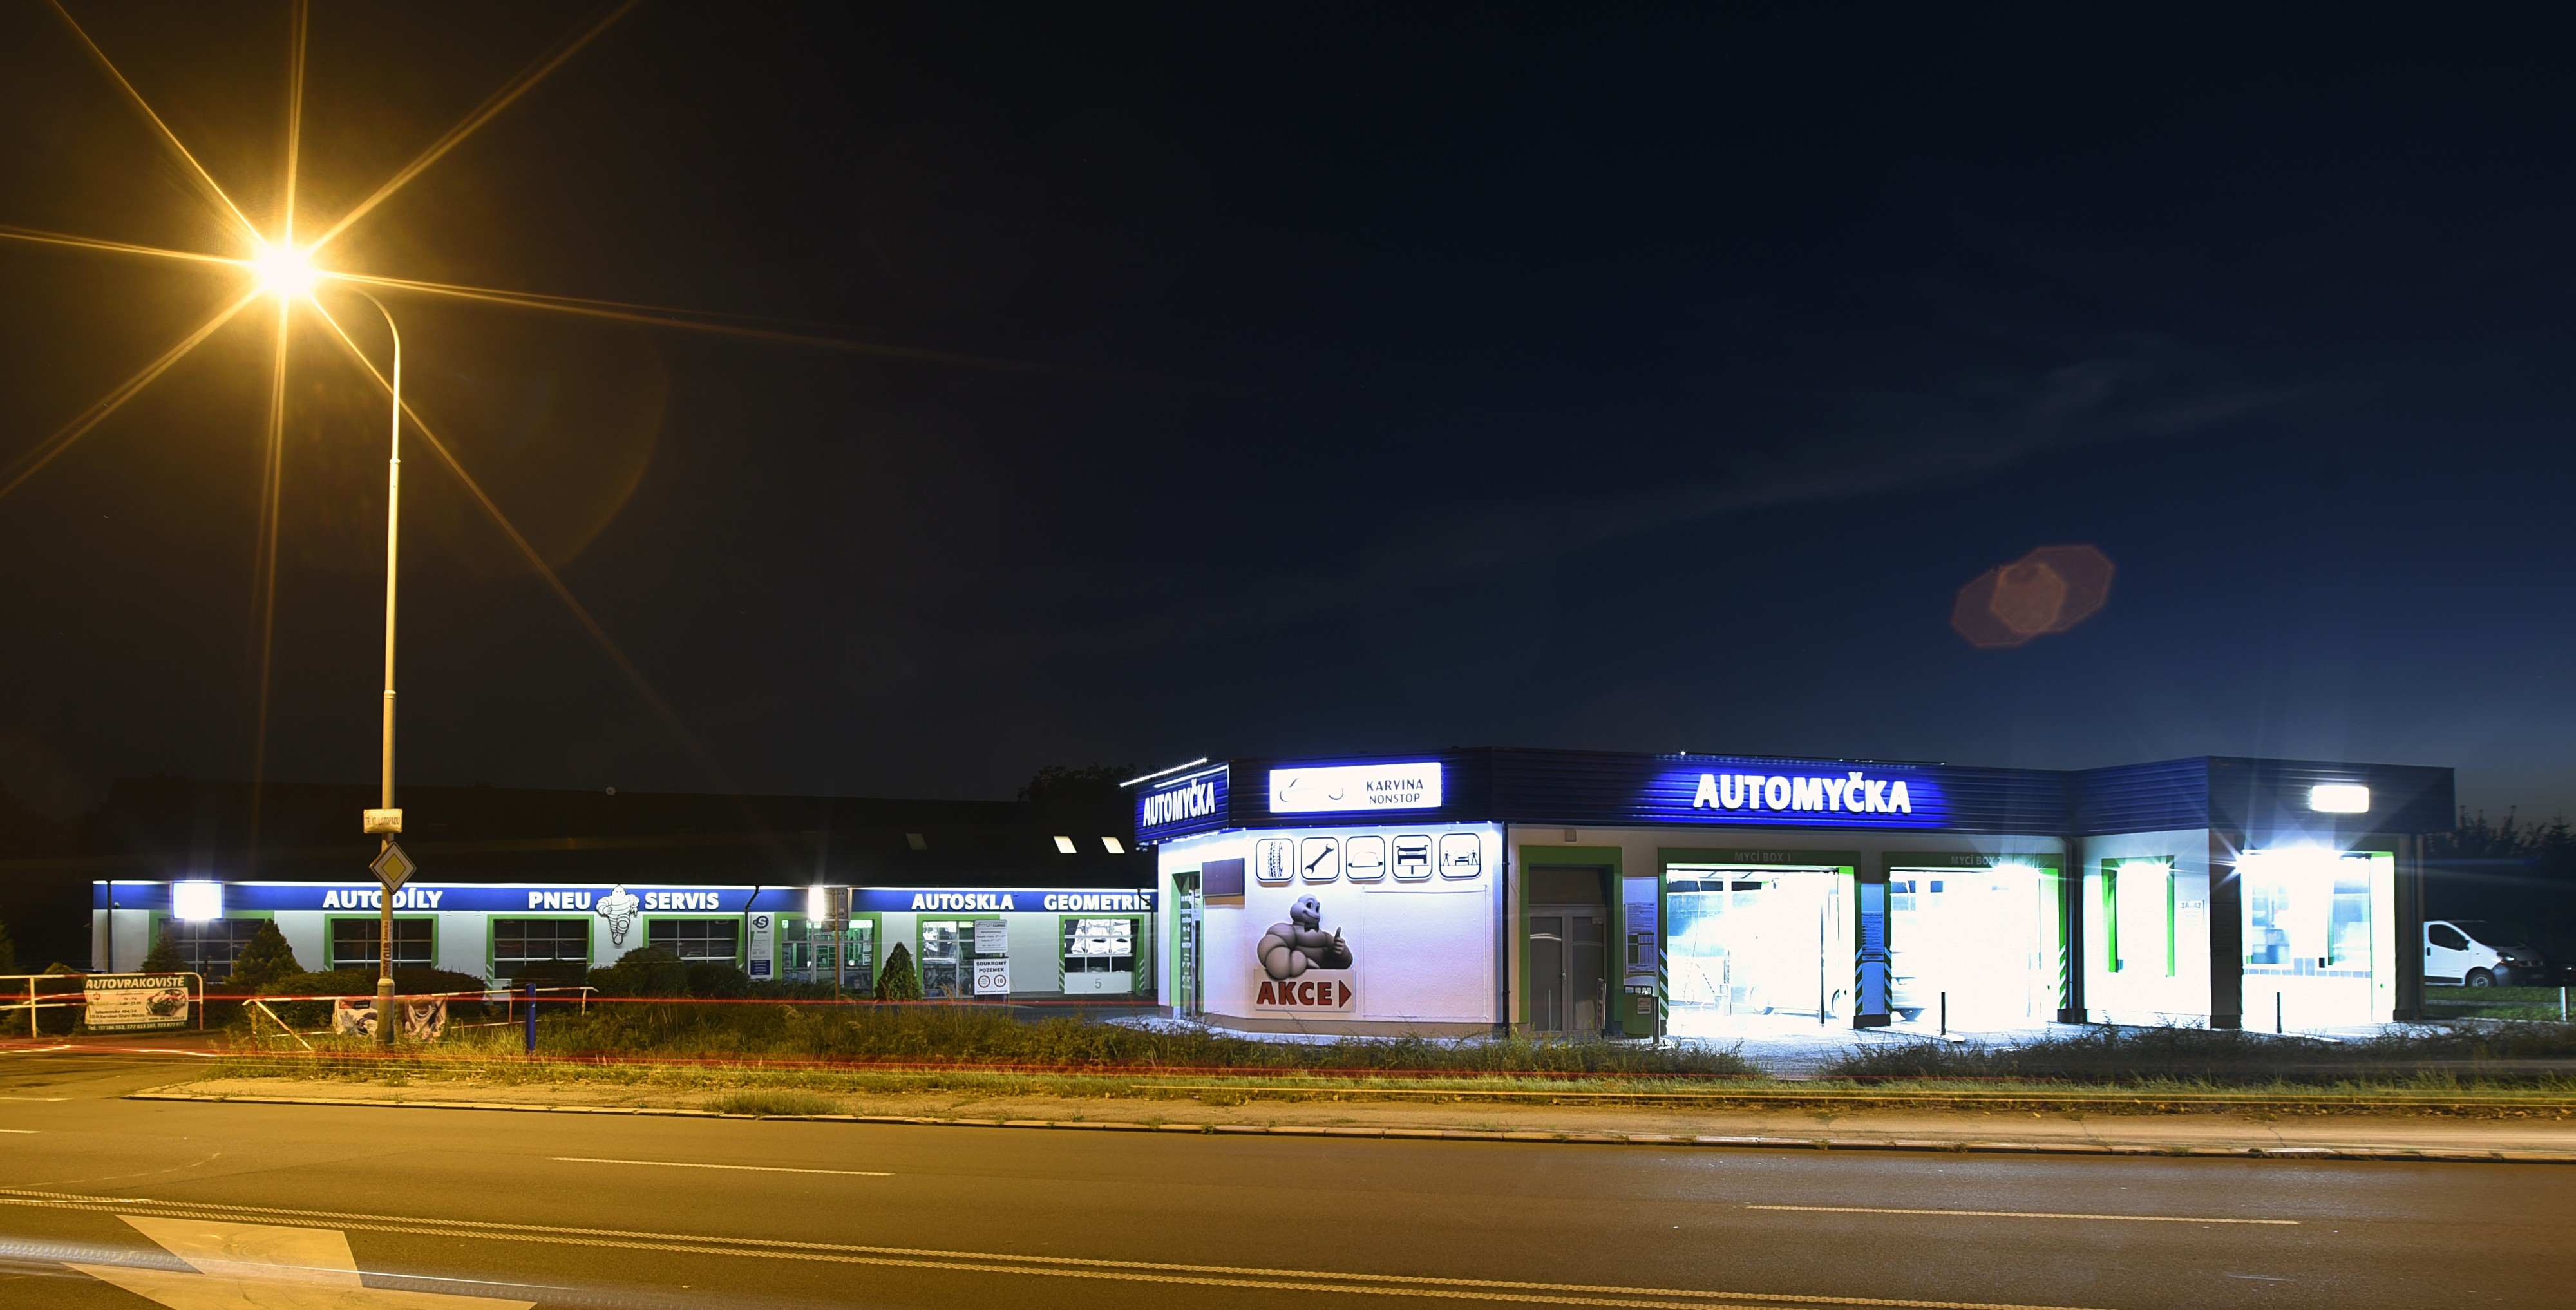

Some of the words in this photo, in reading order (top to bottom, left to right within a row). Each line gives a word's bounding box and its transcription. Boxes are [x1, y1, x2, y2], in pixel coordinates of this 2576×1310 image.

[1369, 793, 1421, 804] NONSTOP
[1693, 772, 1911, 813] AUTOMYČKA
[1142, 779, 1215, 827] AUTOMYČKA
[379, 817, 400, 825] LISTOPADU
[1734, 850, 1759, 862] MYCÍ
[1763, 852, 1783, 862] BOX
[1786, 853, 1791, 862] 1
[1951, 853, 1973, 865] MYCÍ
[1976, 855, 1995, 866] BOX
[323, 887, 444, 910] AUTODÍLY
[528, 891, 591, 910] PNEU
[644, 891, 720, 911] SERVIS
[911, 893, 1014, 911] AUTOSKLA
[1043, 894, 1151, 911] GEOMETRIE
[86, 976, 185, 989] AUTOVRAKOVIŠTĚ
[1095, 978, 1102, 989] 5
[1256, 981, 1332, 1006] AKCE
